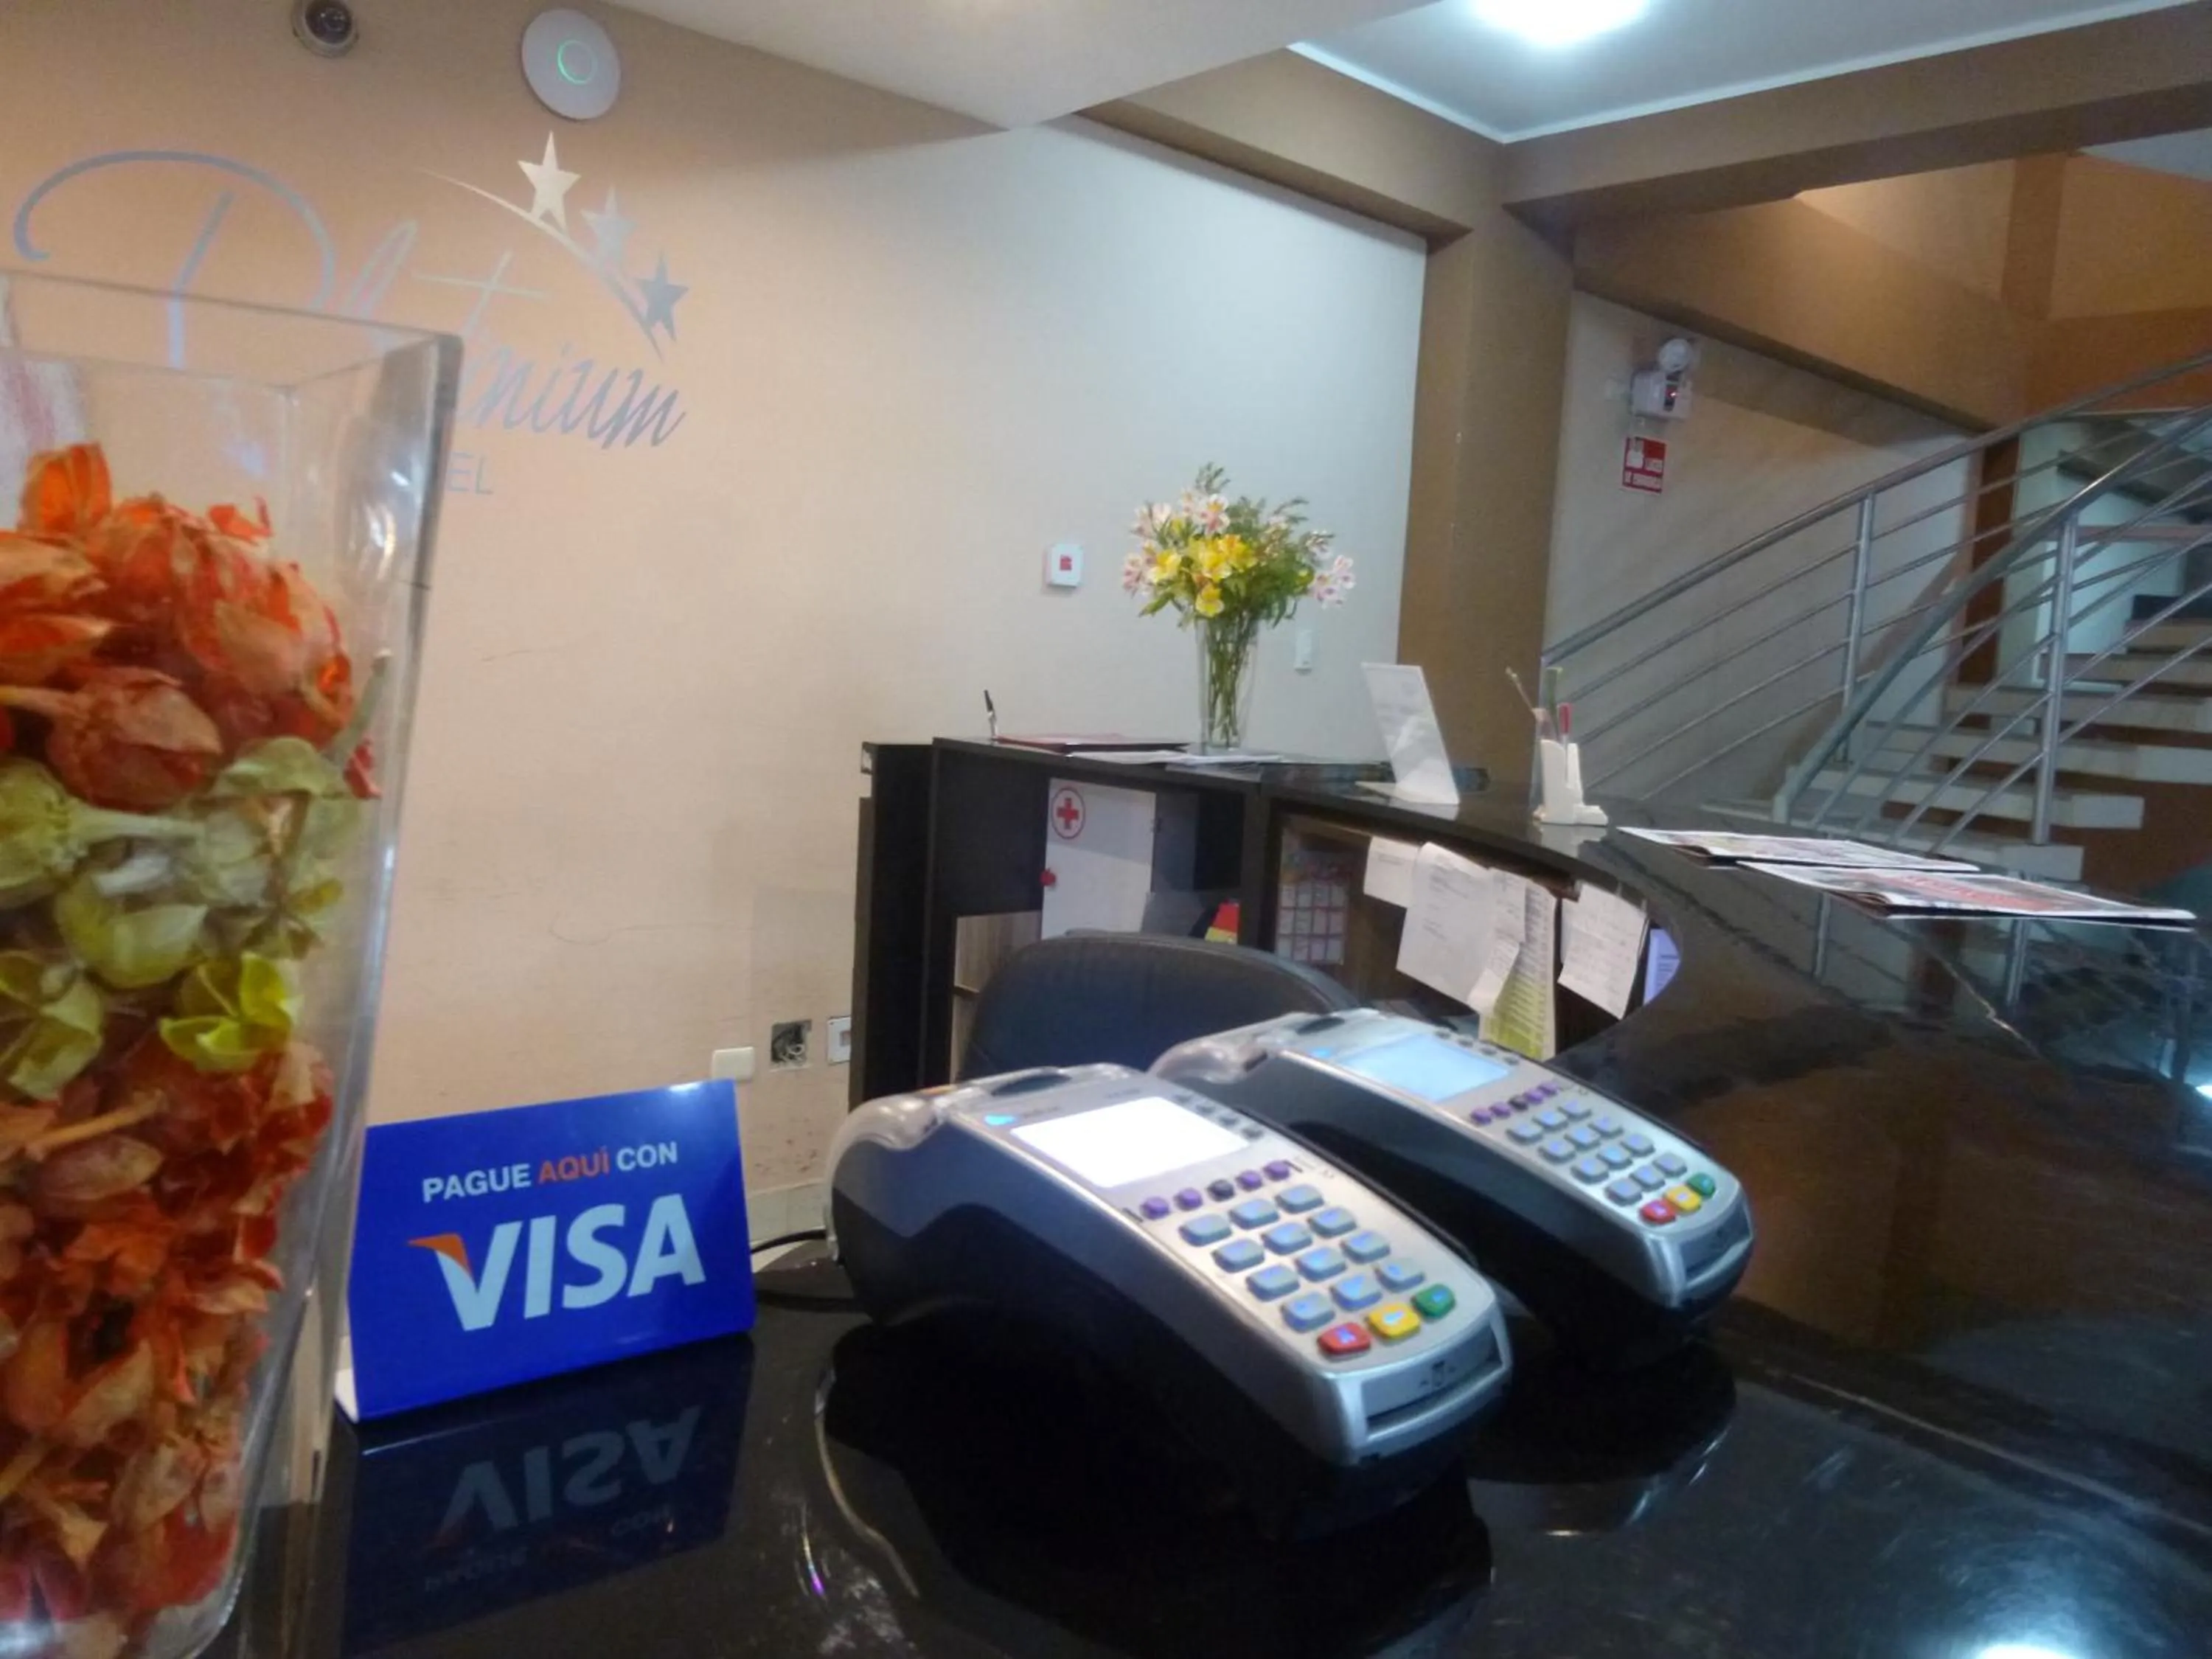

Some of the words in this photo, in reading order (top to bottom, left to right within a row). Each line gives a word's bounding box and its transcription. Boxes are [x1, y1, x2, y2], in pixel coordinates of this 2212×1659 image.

[422, 1164, 531, 1203] PAGUE
[616, 1141, 678, 1172] CON
[408, 1193, 706, 1332] VISA
